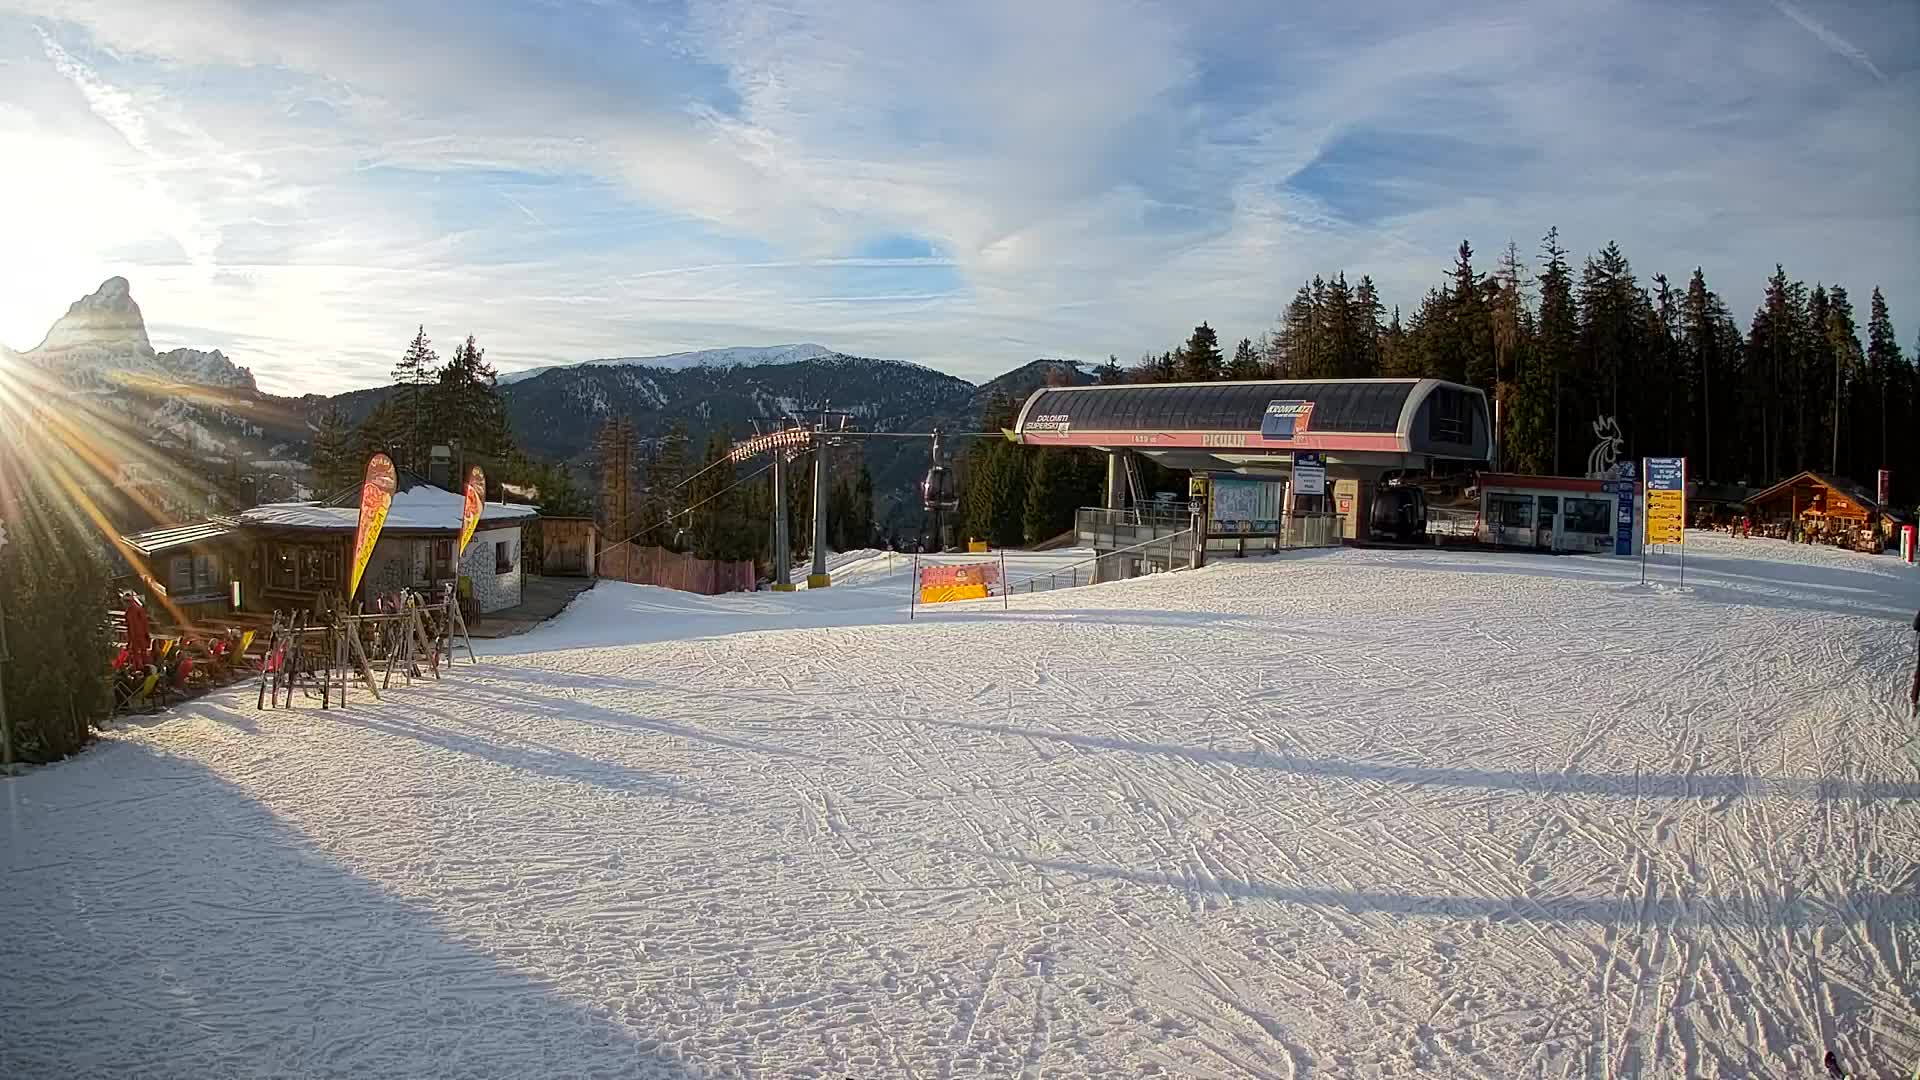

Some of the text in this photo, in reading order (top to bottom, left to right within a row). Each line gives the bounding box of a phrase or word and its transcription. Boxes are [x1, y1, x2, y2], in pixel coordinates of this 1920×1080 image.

[1036, 414, 1069, 422] DOLOMITI
[1026, 422, 1059, 430] SUPERSKI
[1202, 433, 1246, 448] PICULIN
